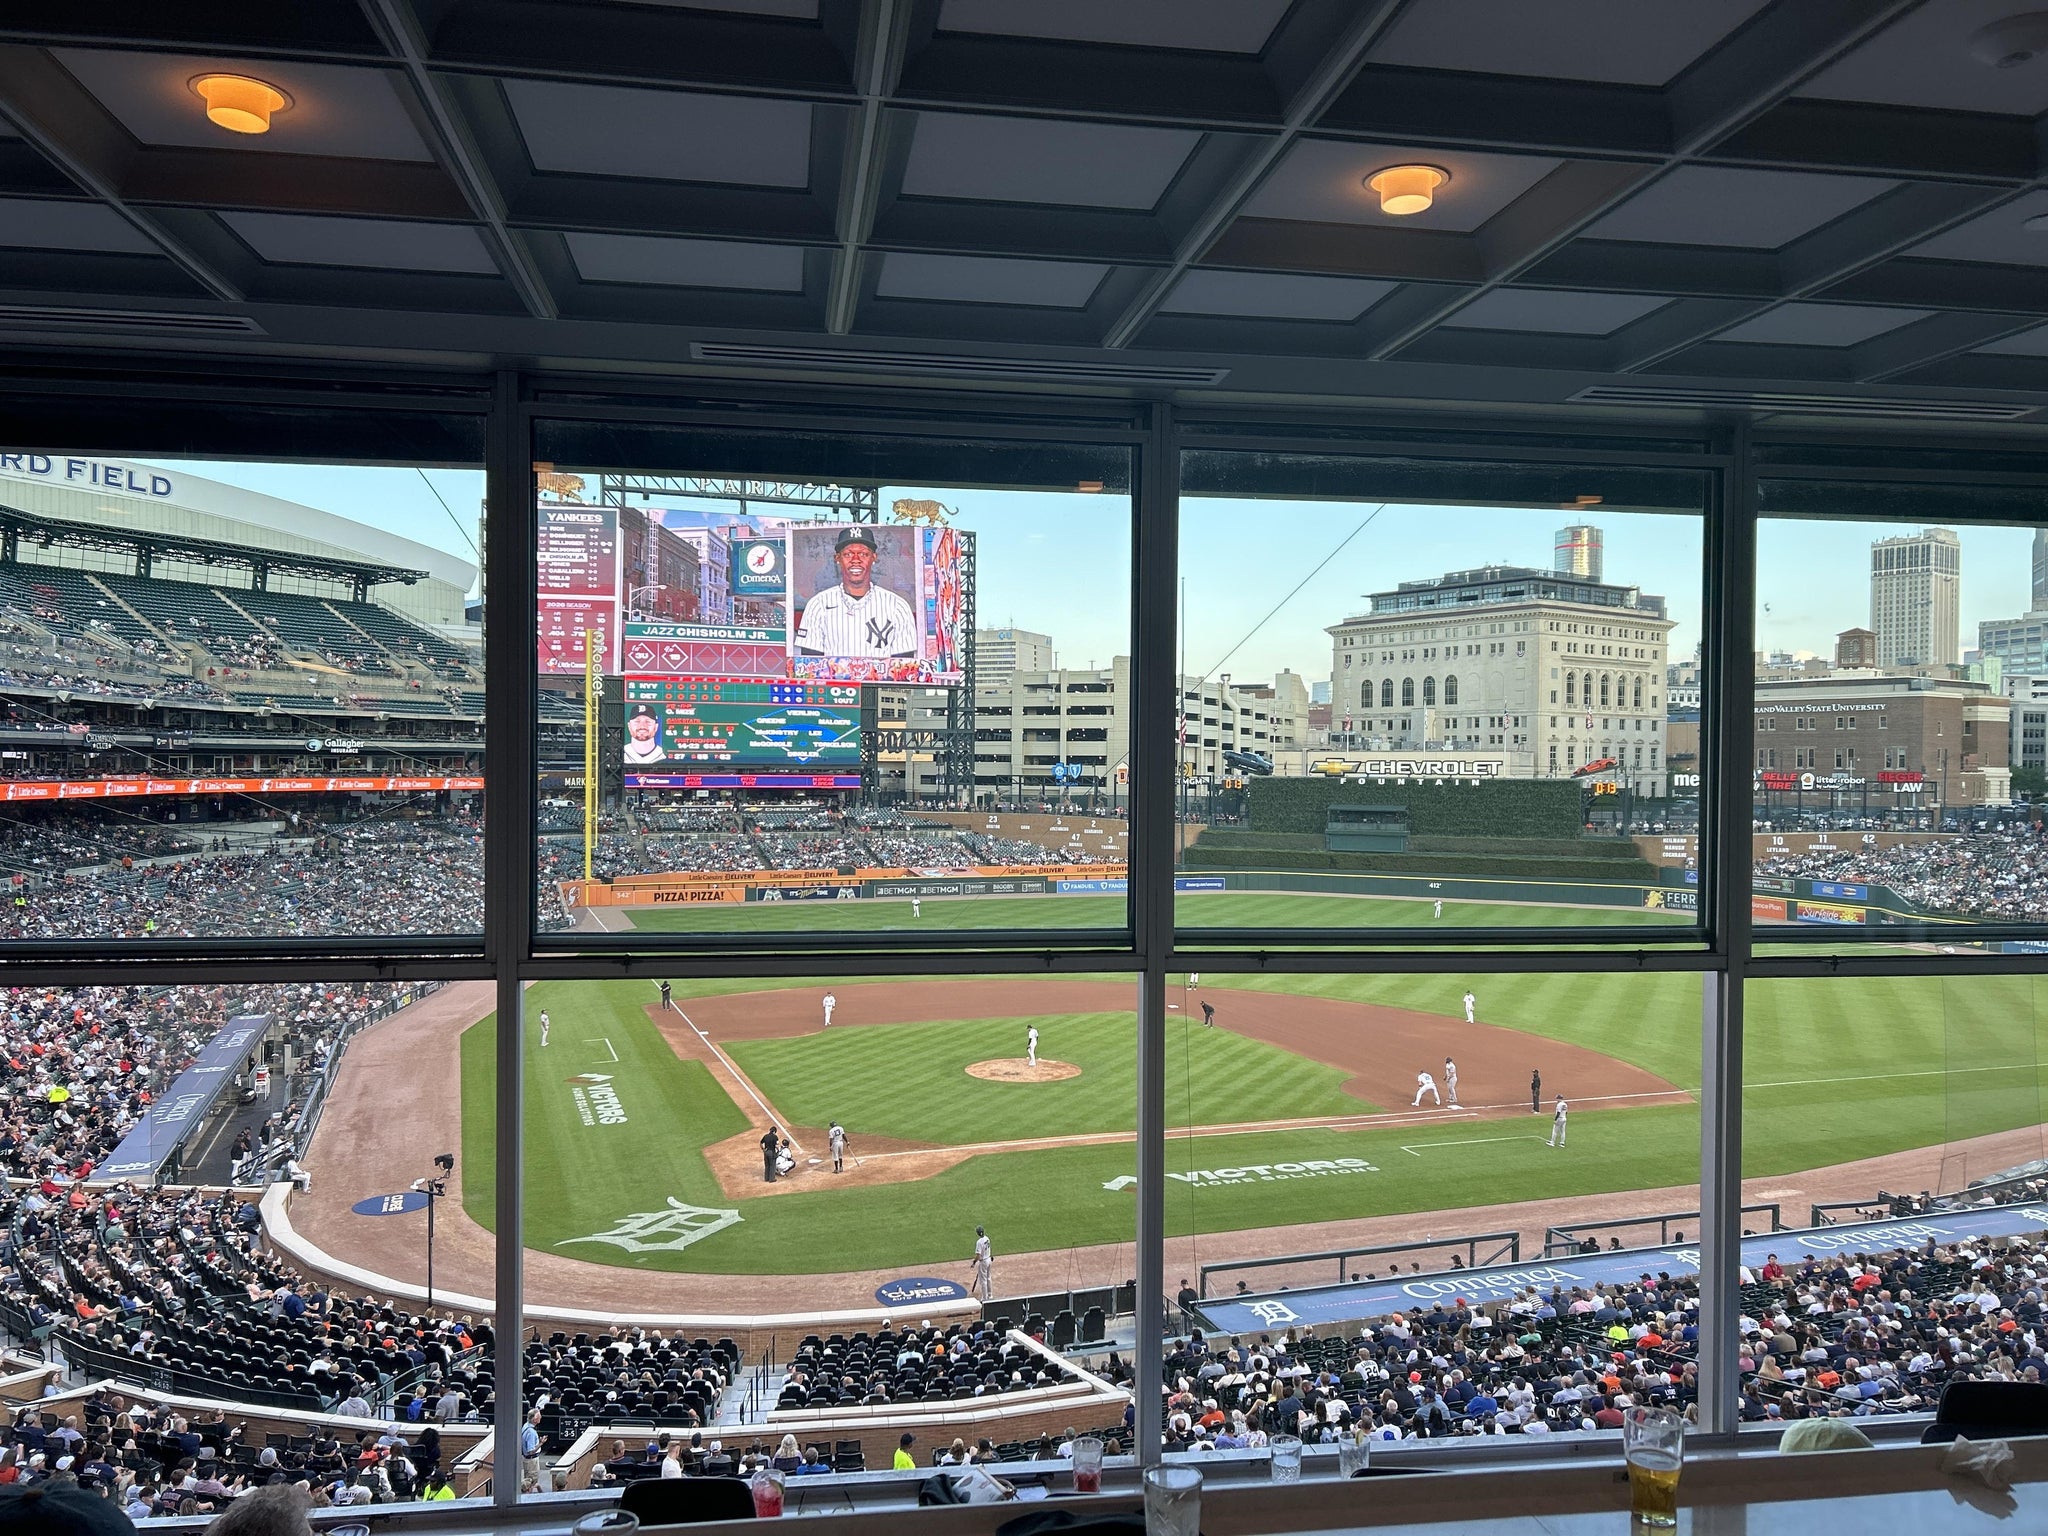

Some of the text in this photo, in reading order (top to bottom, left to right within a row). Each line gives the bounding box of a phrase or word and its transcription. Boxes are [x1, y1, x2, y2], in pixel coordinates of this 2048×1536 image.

[66, 458, 172, 496] FIELD
[700, 478, 788, 497] PARK
[546, 512, 603, 522] YANKEES
[642, 627, 769, 640] JAZZ CHISHOLM JR.
[592, 642, 606, 697] Rocket
[830, 687, 856, 697] 0-0
[1806, 704, 1831, 712] STATE
[85, 733, 117, 743] CHAMPIONS
[324, 739, 365, 748] Gallagher
[1365, 760, 1503, 775] CHEVROLET
[1762, 772, 1798, 781] BELLE
[1878, 772, 1922, 782] FIEGER
[1894, 783, 1922, 793] LAW
[1772, 836, 1783, 845] 10
[1818, 835, 1827, 843] 11
[1862, 834, 1875, 843] 42
[654, 891, 724, 902] PIZZA! PIZZA!
[1803, 905, 1839, 920] Surfside
[587, 1083, 628, 1124] VICTORS
[1164, 1158, 1370, 1182] VICTORS
[1193, 1166, 1381, 1188] HOME SOLUTIONS
[1859, 1234, 1937, 1251] PARK
[1466, 1284, 1554, 1300] PARK
[1365, 1366, 1378, 1377] 24
